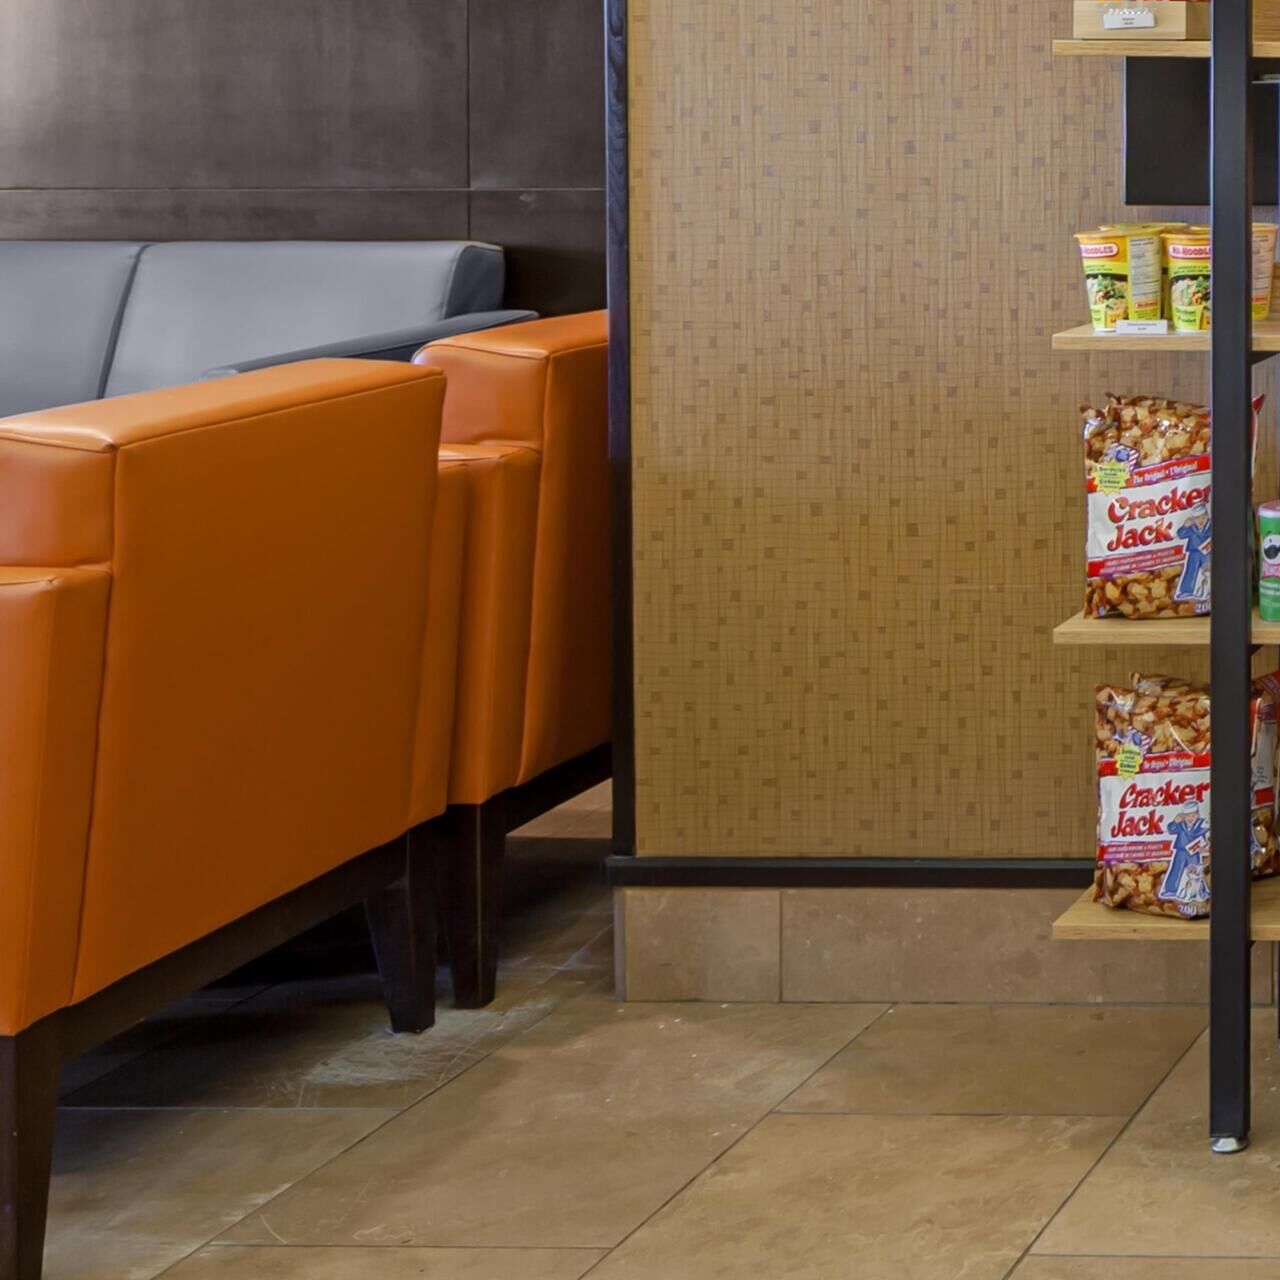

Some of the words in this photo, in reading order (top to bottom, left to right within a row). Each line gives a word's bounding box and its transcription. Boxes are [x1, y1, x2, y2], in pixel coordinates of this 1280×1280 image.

[1107, 517, 1174, 552] Jack
[1119, 778, 1211, 809] Cracker
[1111, 809, 1164, 838] Jack
